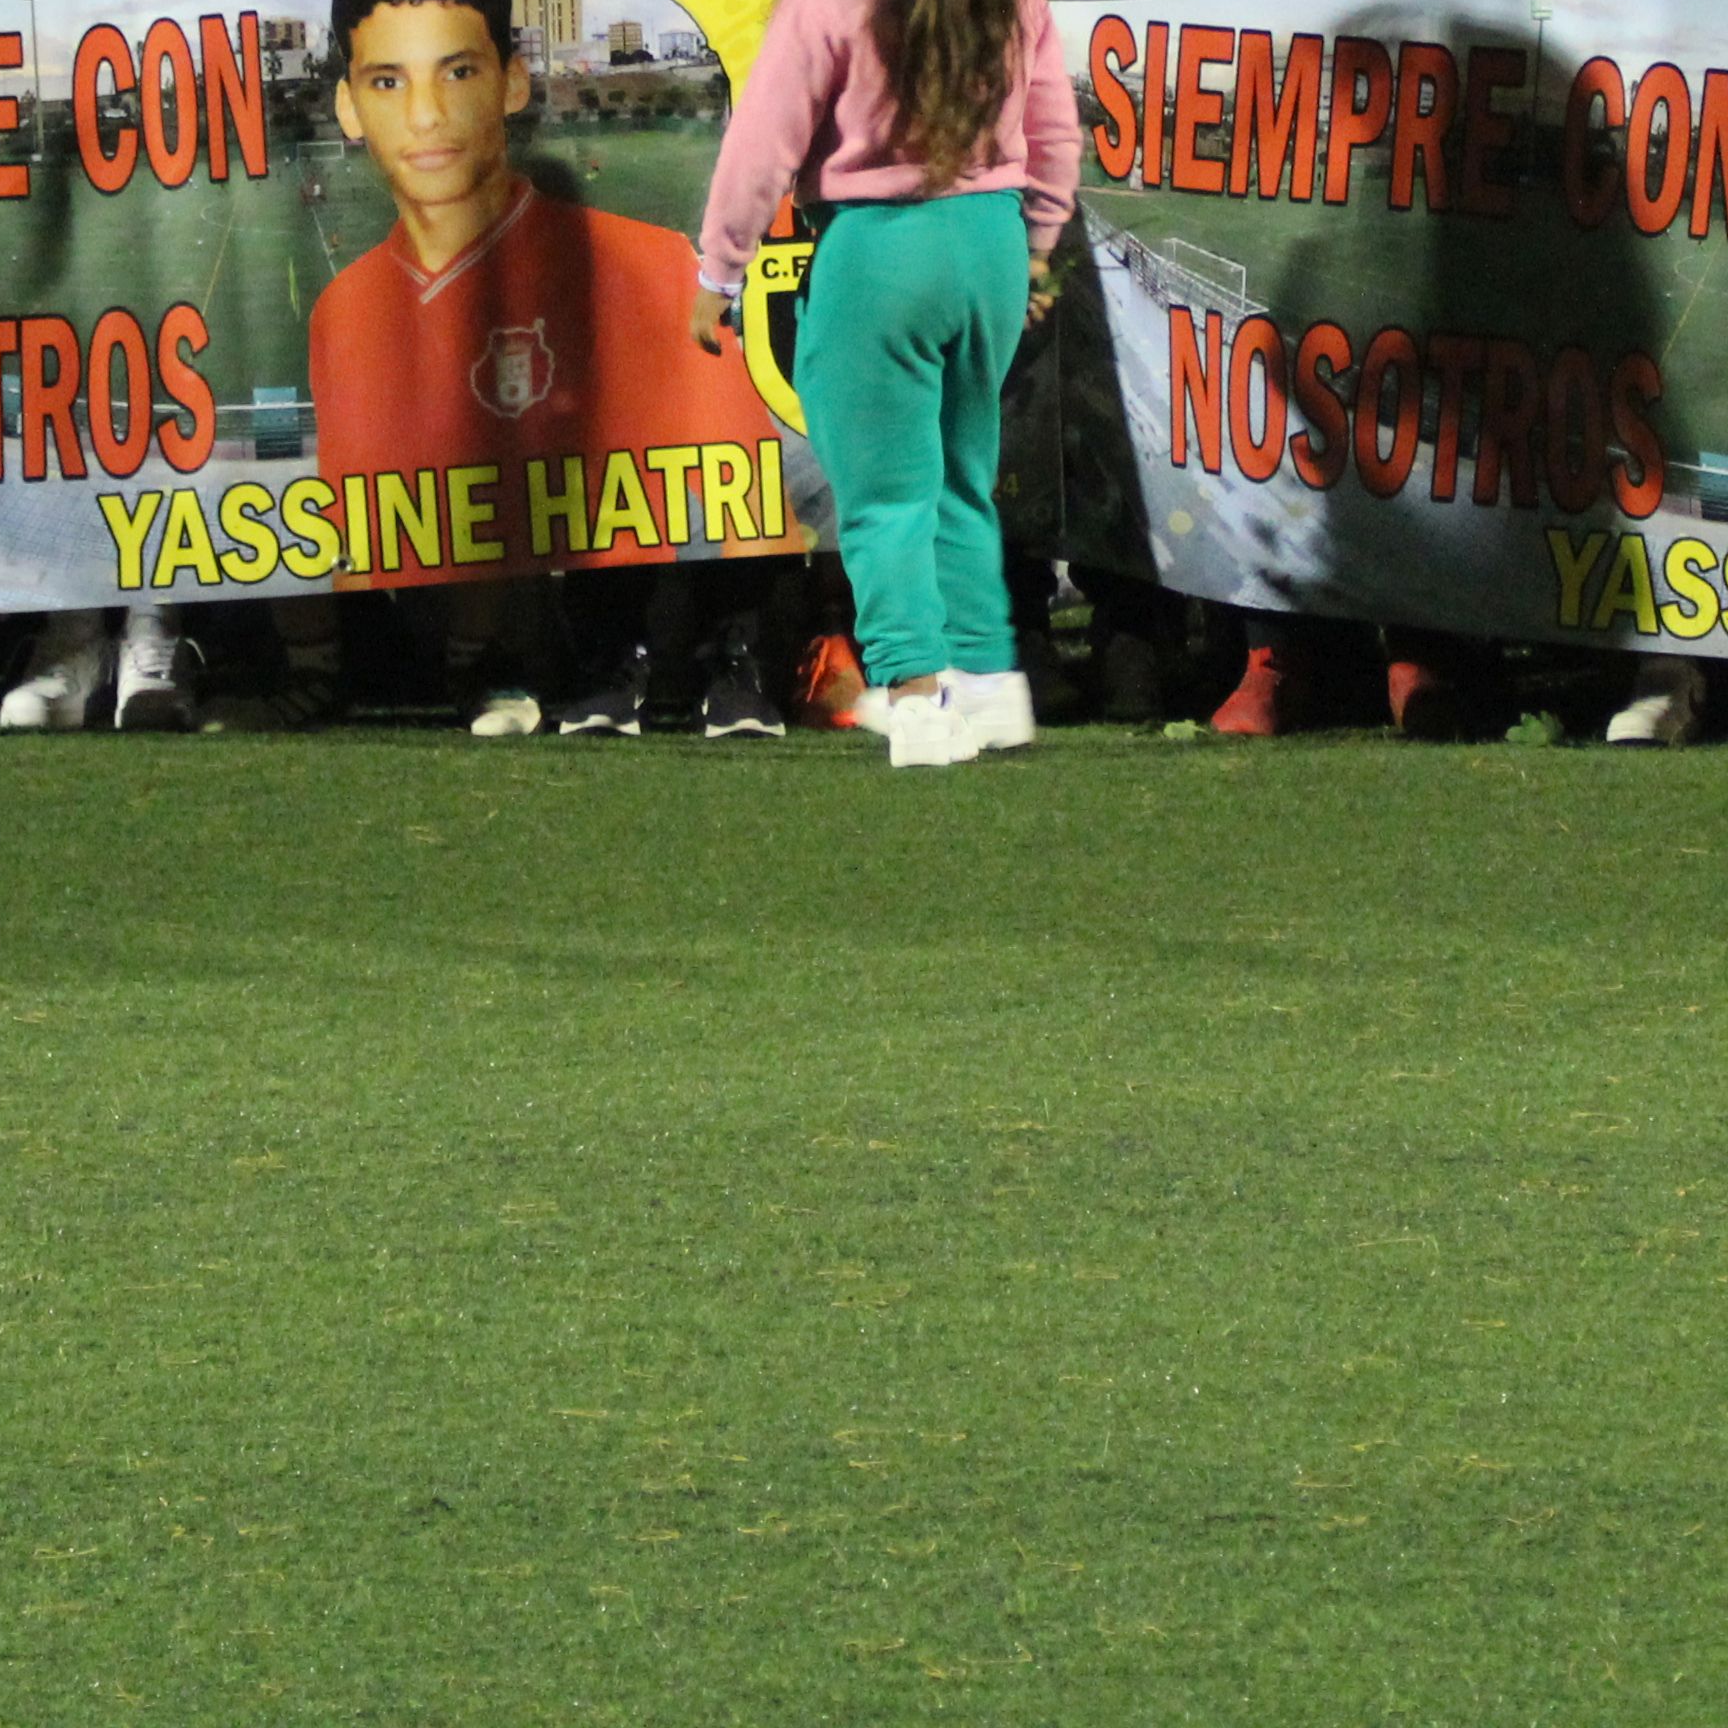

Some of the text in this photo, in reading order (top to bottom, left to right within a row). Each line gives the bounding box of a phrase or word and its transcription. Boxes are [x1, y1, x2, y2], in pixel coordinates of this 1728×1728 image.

[71, 11, 269, 197] CON
[1088, 14, 1527, 216] SIEMPRE
[1169, 304, 1665, 520] NOSOTROS
[97, 438, 785, 591] YASSINE HATRI
